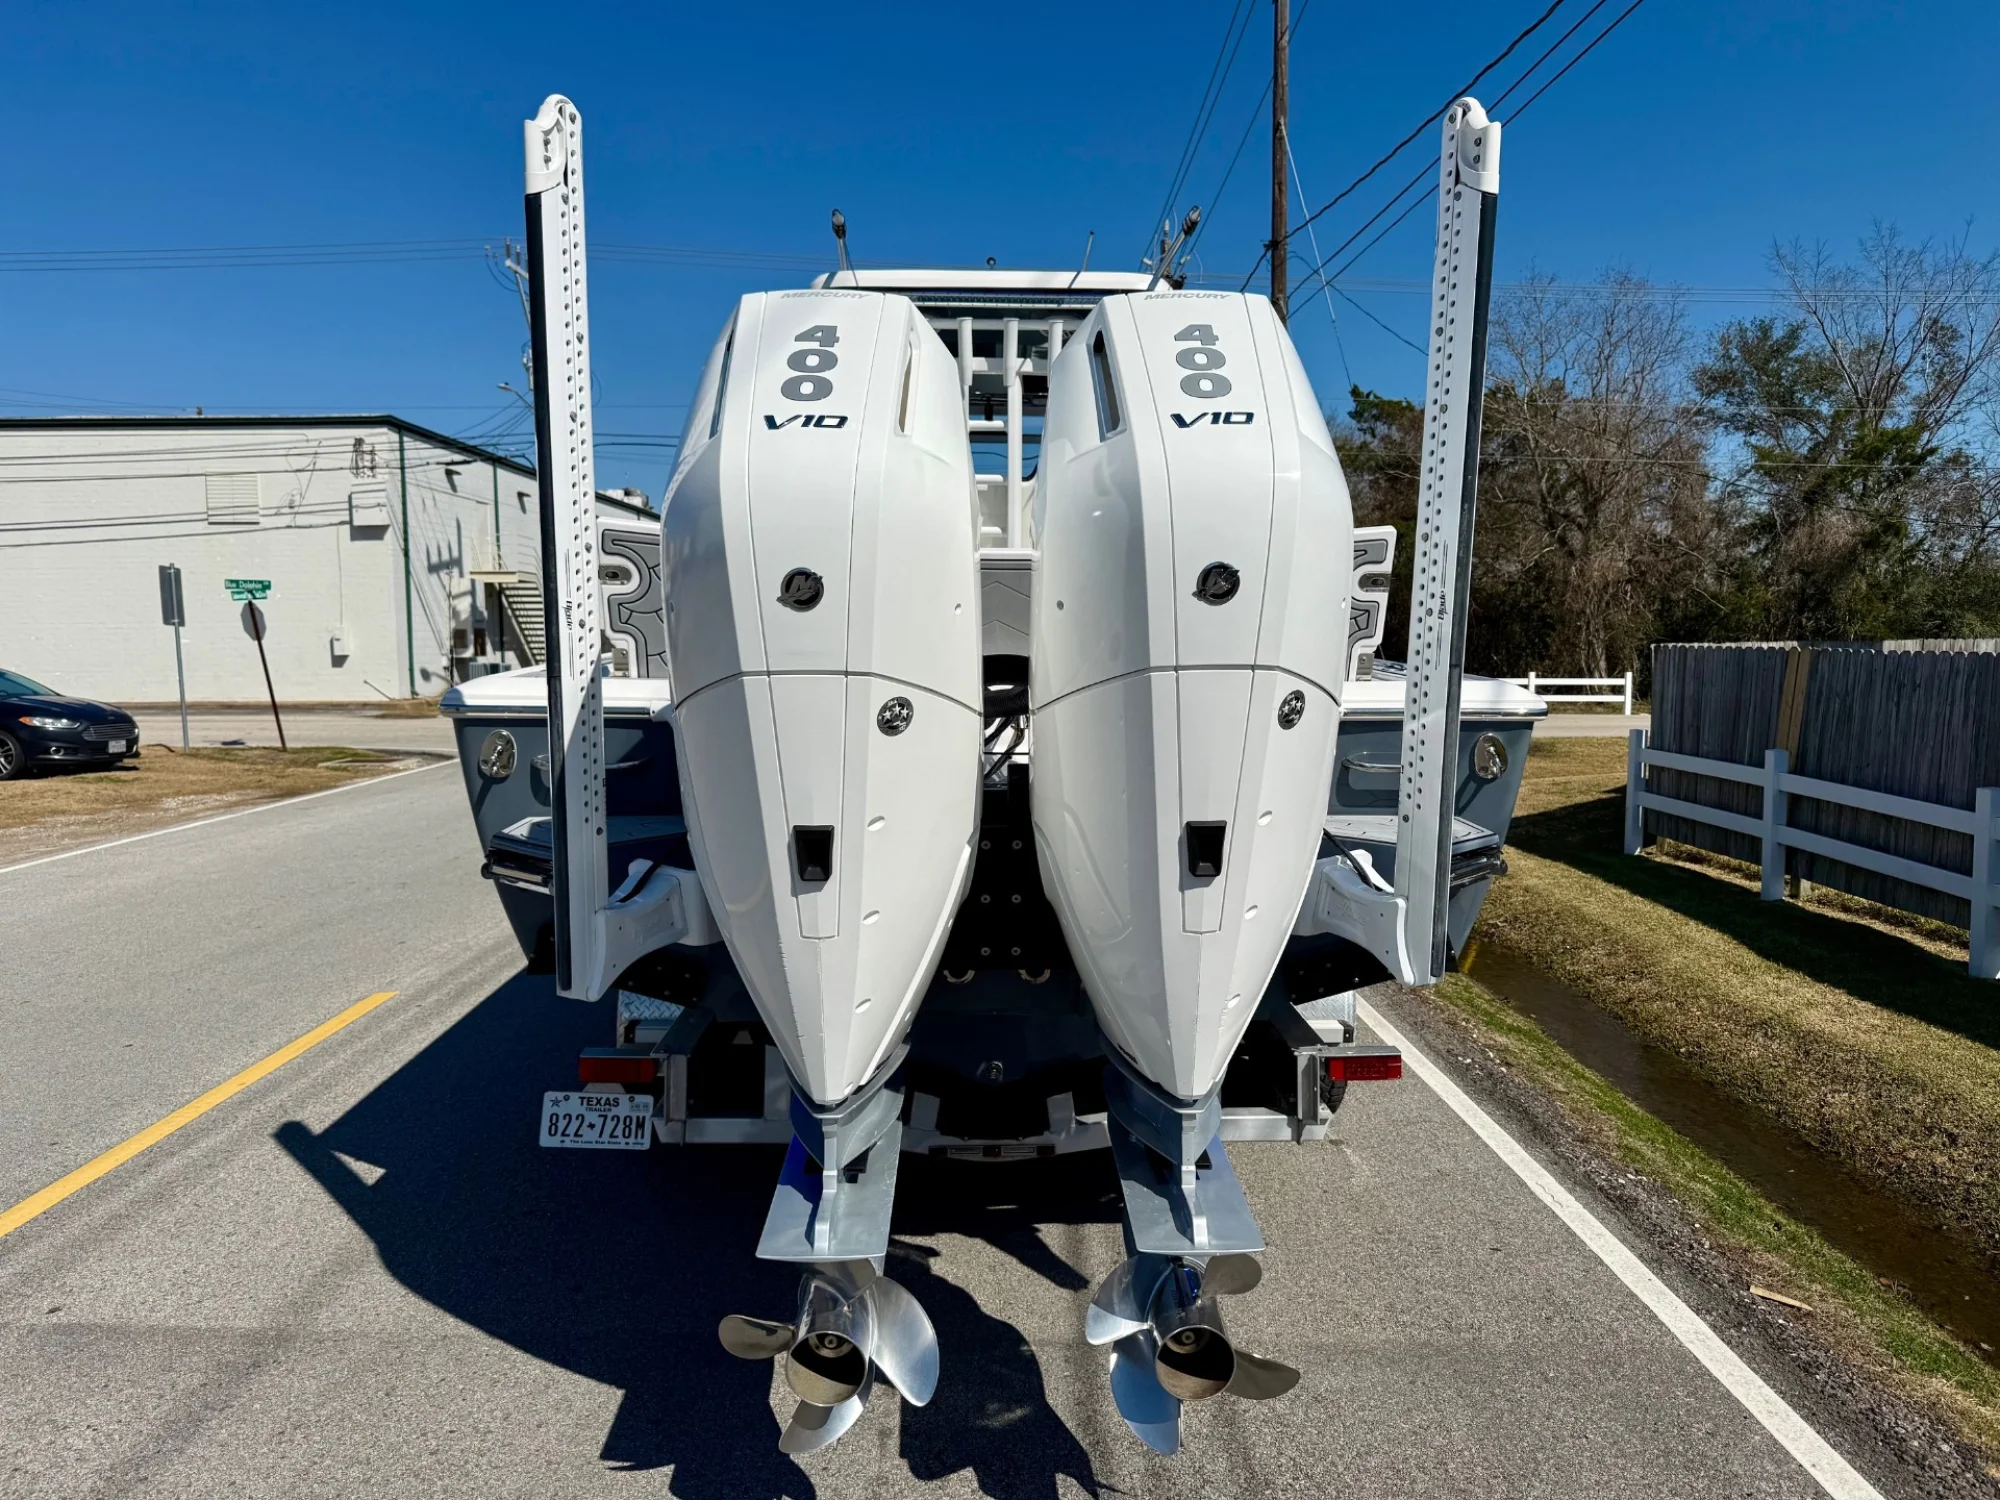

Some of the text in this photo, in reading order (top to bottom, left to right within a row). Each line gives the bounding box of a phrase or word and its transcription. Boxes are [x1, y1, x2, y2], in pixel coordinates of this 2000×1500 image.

[1144, 292, 1231, 300] MERCURY
[781, 325, 839, 401] 400
[1174, 324, 1232, 398] 400
[763, 414, 848, 430] V10
[1170, 411, 1255, 428] V10
[578, 1096, 620, 1108] TEXAS
